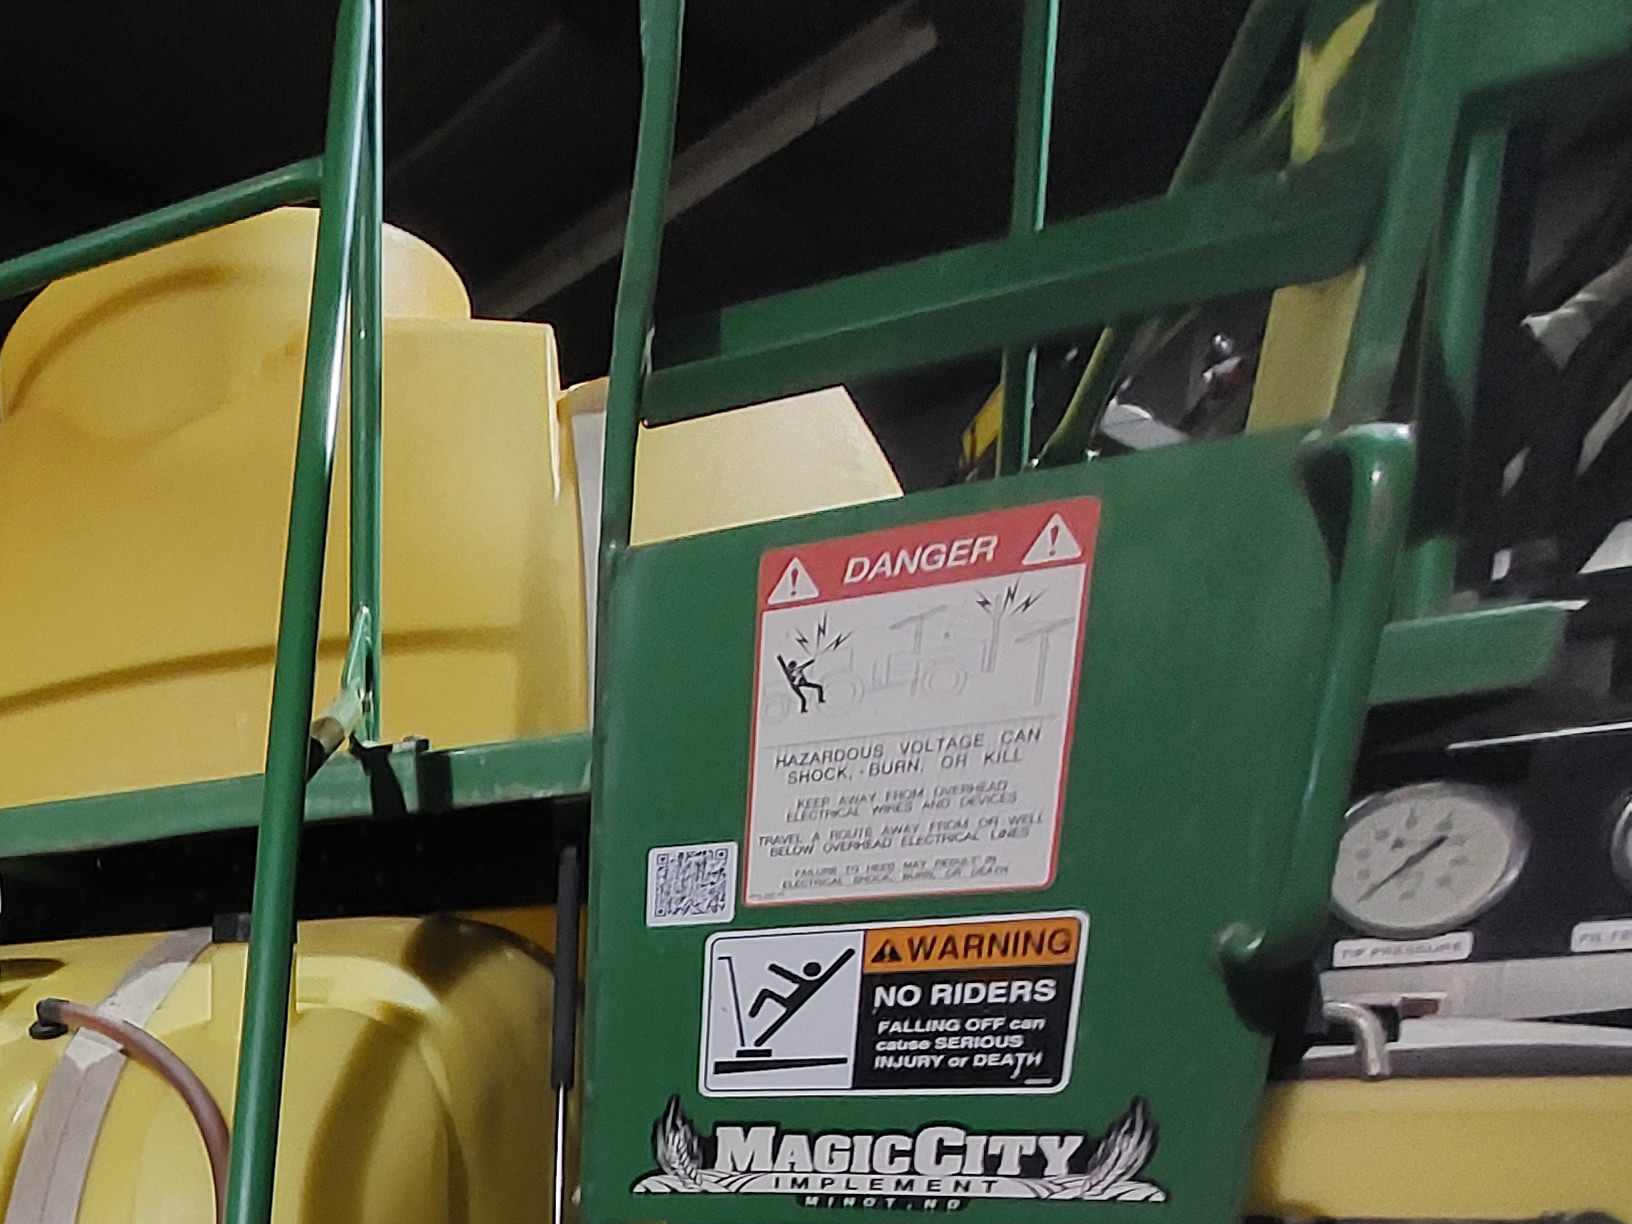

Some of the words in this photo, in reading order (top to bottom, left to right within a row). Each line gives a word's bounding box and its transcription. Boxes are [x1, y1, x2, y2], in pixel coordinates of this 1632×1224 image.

[843, 534, 998, 584] DANGER
[775, 743, 884, 769] HAZARDOUS
[900, 732, 985, 756] VOLTAGE
[1000, 727, 1042, 746] CAN
[787, 766, 854, 785] SHOCK,
[941, 753, 967, 769] OR
[983, 747, 1024, 766] KILL
[786, 807, 860, 823] ELECTRICAL
[872, 800, 913, 815] WIRES
[921, 797, 951, 811] AND
[960, 791, 1017, 808] DEVICES
[796, 796, 831, 810] KEEP
[839, 791, 877, 806] AWAY
[885, 786, 925, 803] FROM
[933, 779, 1009, 797] OVERHEAD
[758, 834, 804, 847] TRAVEL
[811, 832, 820, 843] A
[829, 826, 873, 840] ROUTE
[881, 823, 920, 837] AWAY
[929, 817, 969, 832] FROM
[978, 815, 999, 828] OR
[1008, 811, 1043, 825] WELL
[769, 844, 816, 857] BELOW
[822, 837, 893, 854] OVERHEAD
[900, 831, 980, 848] ELECTRICAL
[907, 928, 1073, 962] WARNING
[873, 984, 922, 1008] NO
[930, 978, 1057, 1006] RIDERS
[877, 1018, 961, 1035] FALLING
[965, 1017, 1006, 1031] OFF
[1009, 1018, 1046, 1031] can
[875, 1039, 931, 1052] cause
[934, 1035, 1025, 1050] SERIOUS
[874, 1055, 945, 1070] INJURY
[947, 1056, 968, 1068] or
[972, 1051, 1044, 1069] DEATH
[774, 1177, 998, 1192] IMPLEMENT
[923, 1198, 961, 1211] ND
